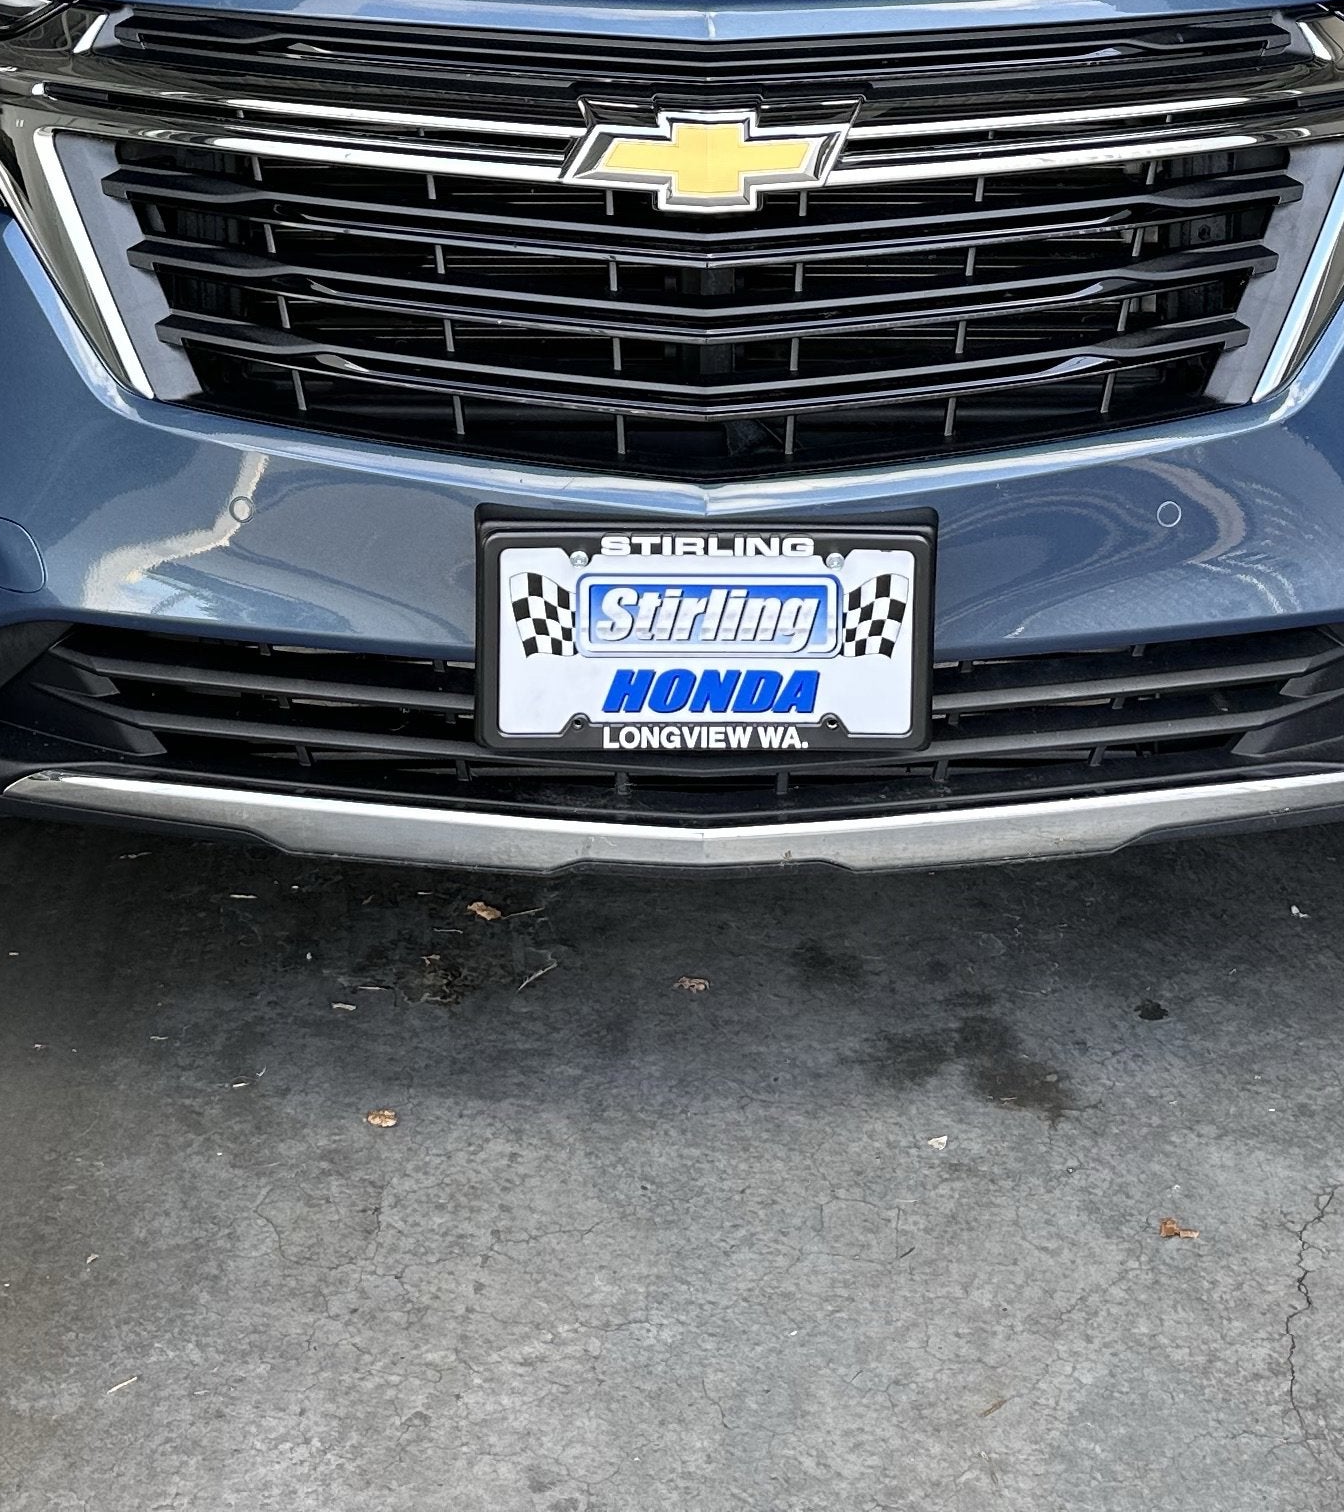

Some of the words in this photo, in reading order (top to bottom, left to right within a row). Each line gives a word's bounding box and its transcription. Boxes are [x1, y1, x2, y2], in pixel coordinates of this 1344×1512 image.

[600, 536, 814, 557] STIRLING
[596, 587, 821, 653] Stirling
[601, 669, 820, 714] HONDA
[602, 726, 752, 749] LONGVIEW
